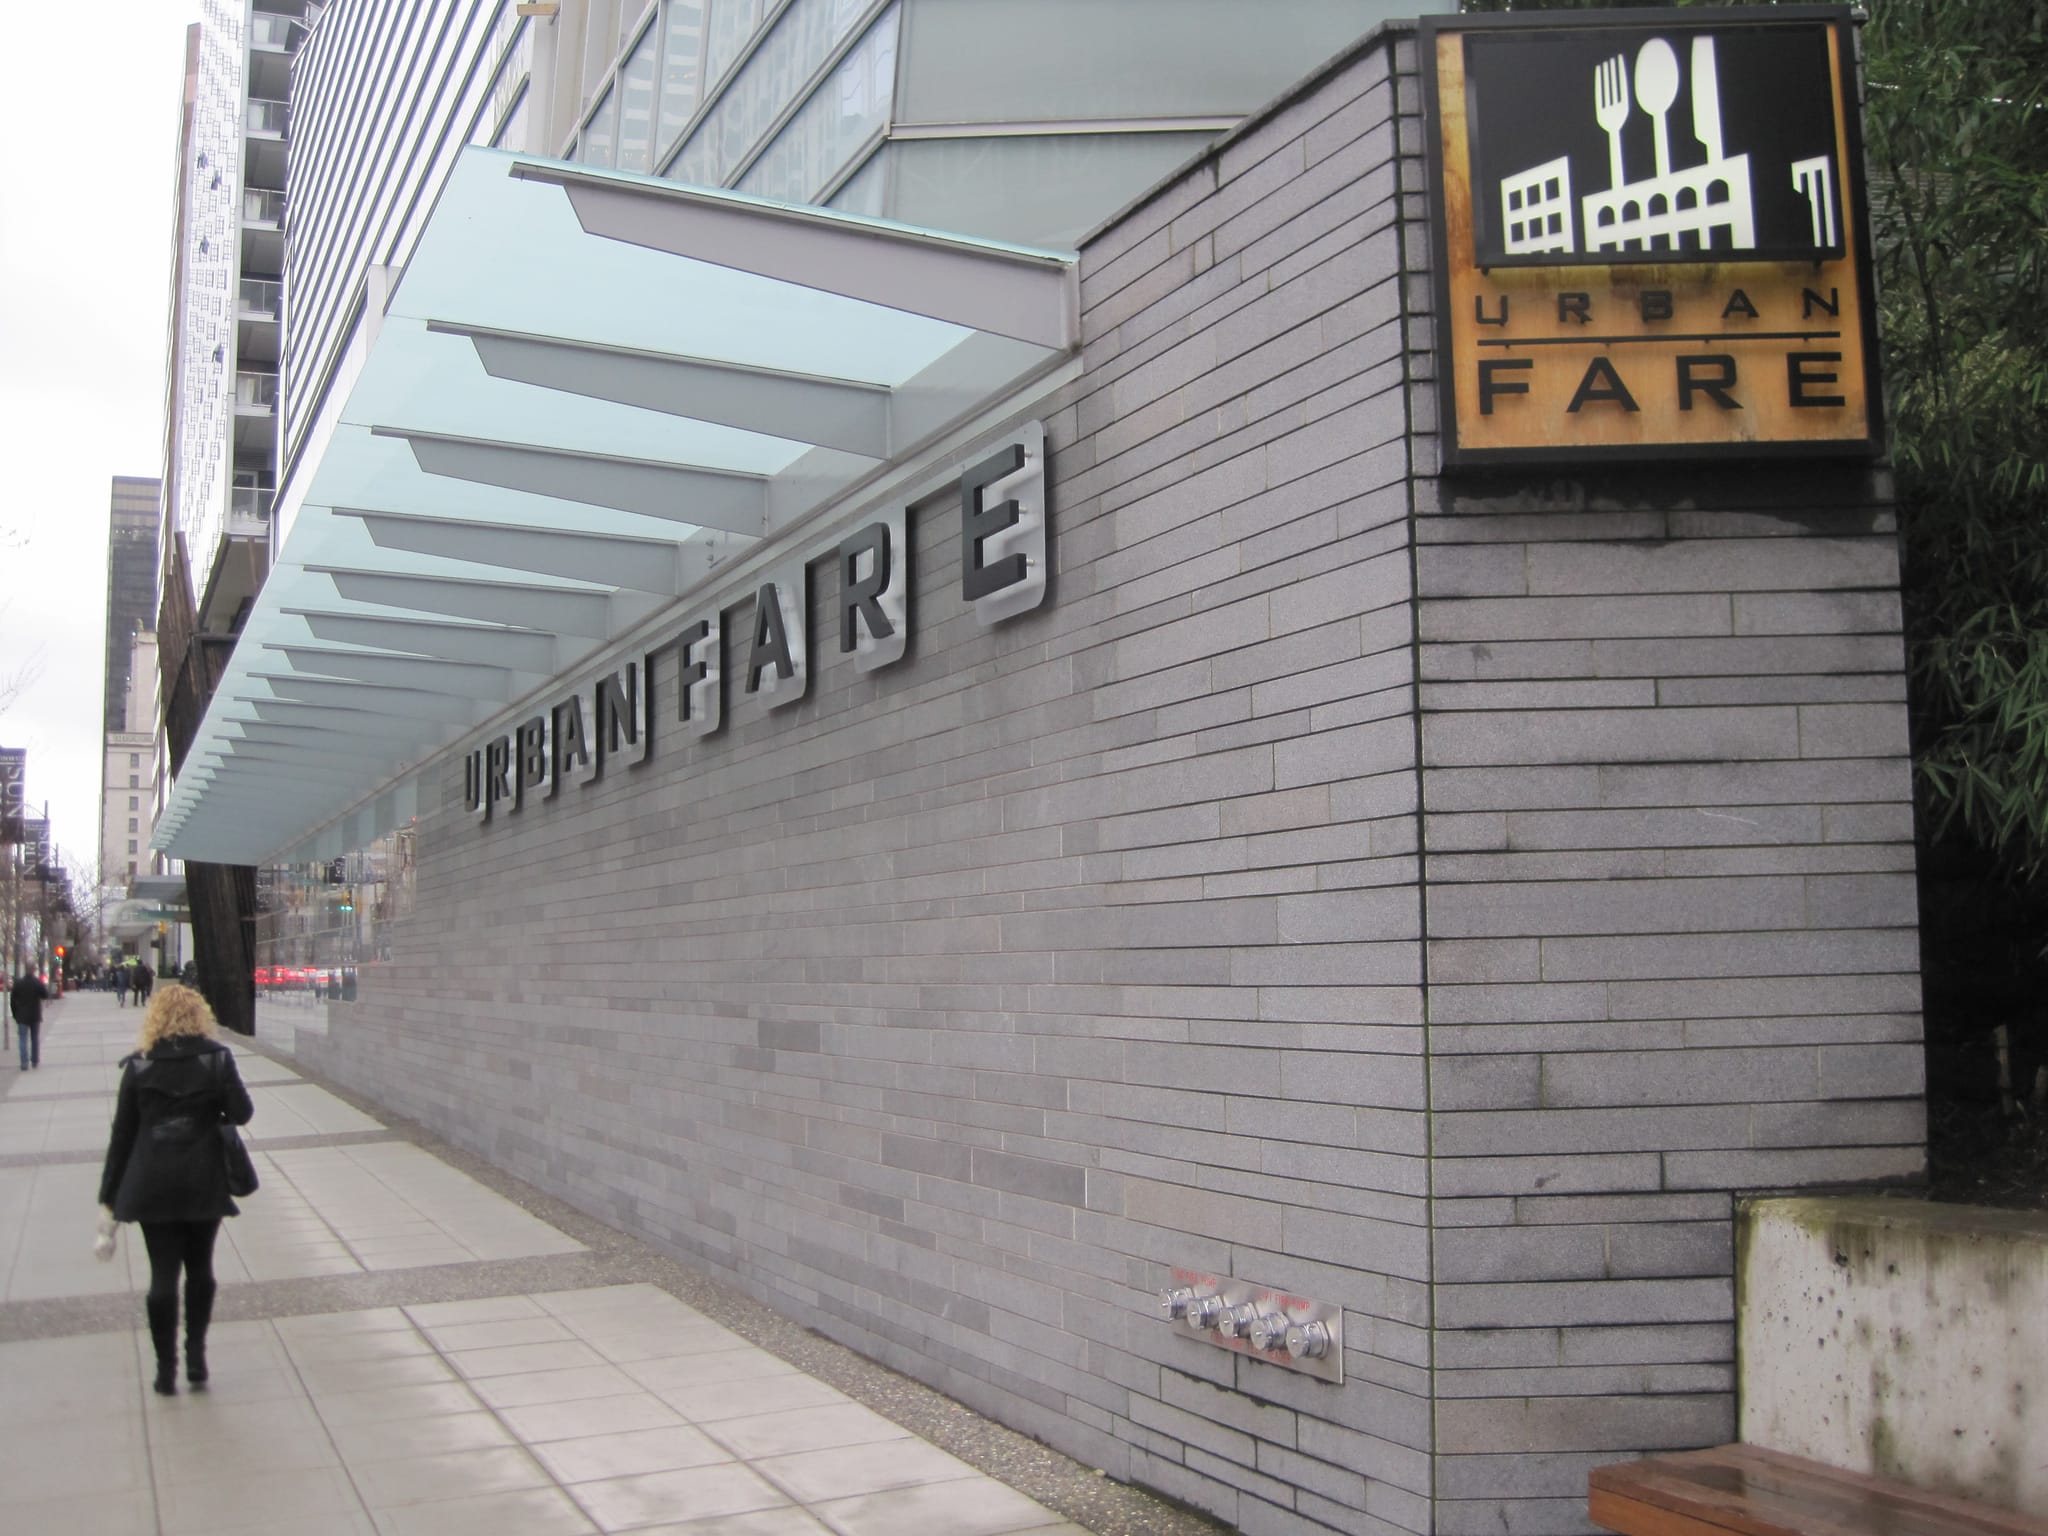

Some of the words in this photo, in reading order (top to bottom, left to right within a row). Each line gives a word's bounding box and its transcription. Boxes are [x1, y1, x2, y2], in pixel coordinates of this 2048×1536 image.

[1475, 287, 1840, 326] URBAN
[1477, 351, 1846, 415] FARE
[464, 661, 638, 813] URBAN
[678, 443, 1028, 722] FARE
